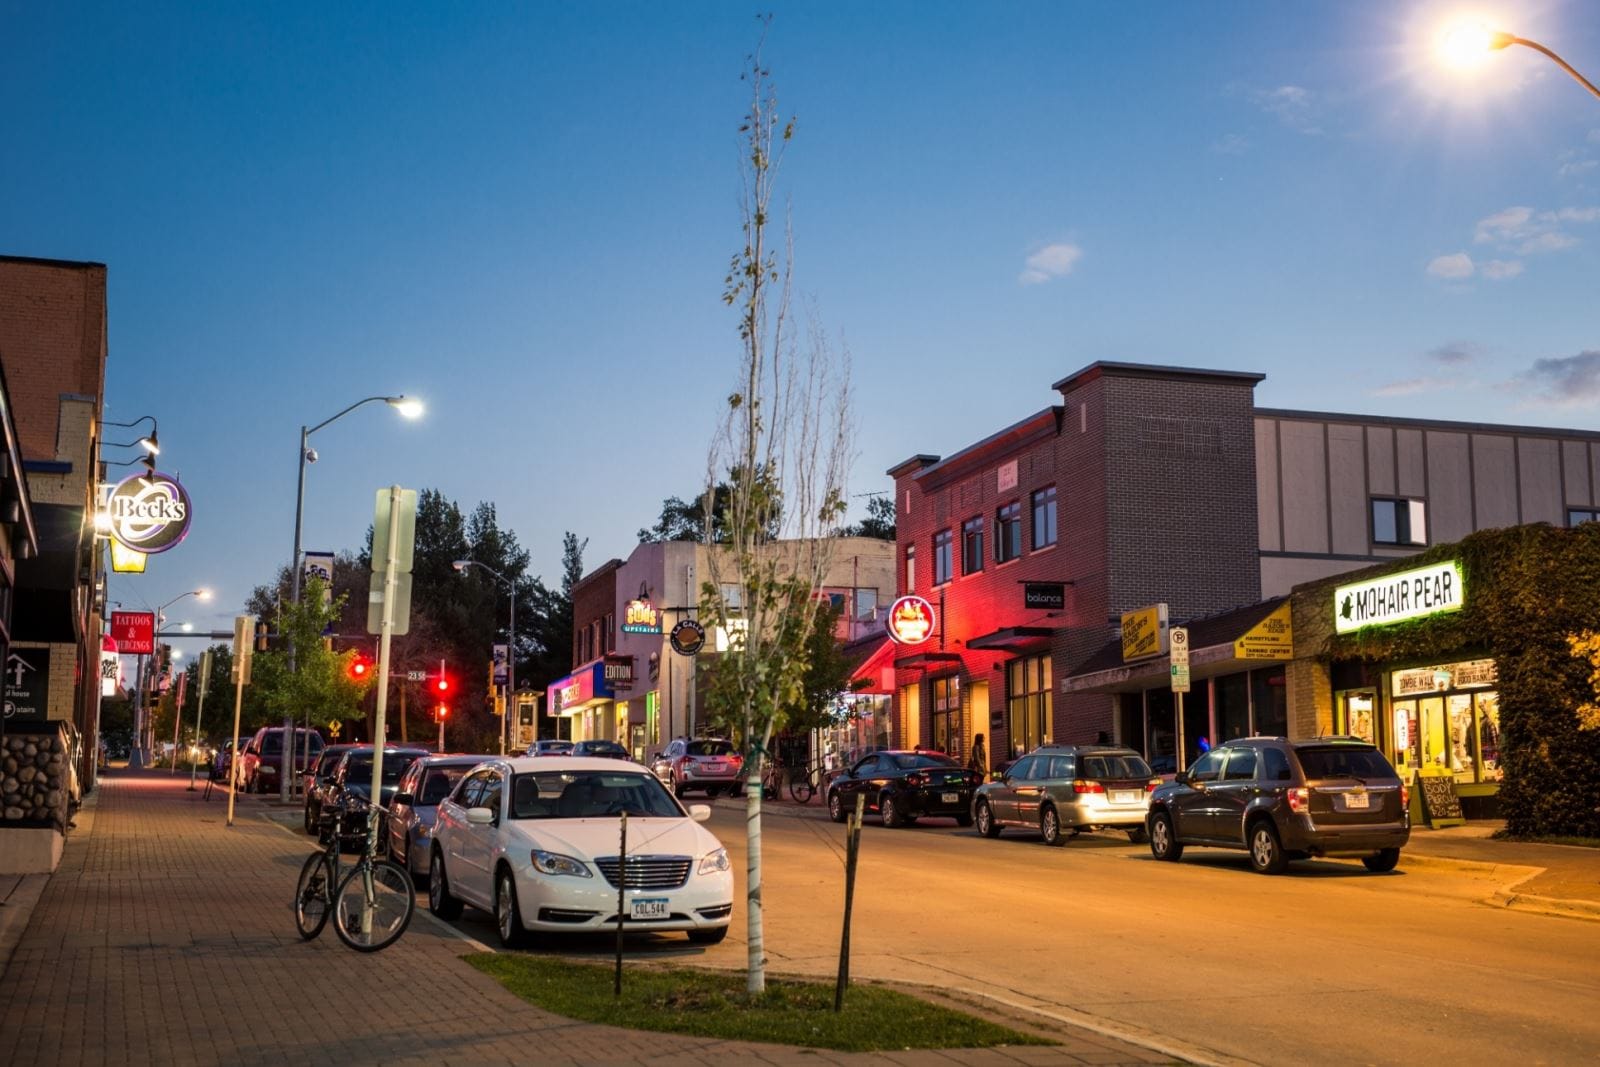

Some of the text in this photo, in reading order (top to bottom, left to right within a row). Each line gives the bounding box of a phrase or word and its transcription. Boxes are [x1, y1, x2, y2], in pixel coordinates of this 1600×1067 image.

[115, 496, 185, 521] Beck's
[1027, 592, 1062, 602] balance
[1356, 571, 1453, 621] MOHAIR PEAR
[115, 615, 151, 626] TATTOOS
[128, 627, 136, 639] &
[624, 625, 660, 633] UPSTAIRS
[605, 664, 632, 680] EDITION
[1424, 783, 1452, 794] BODY
